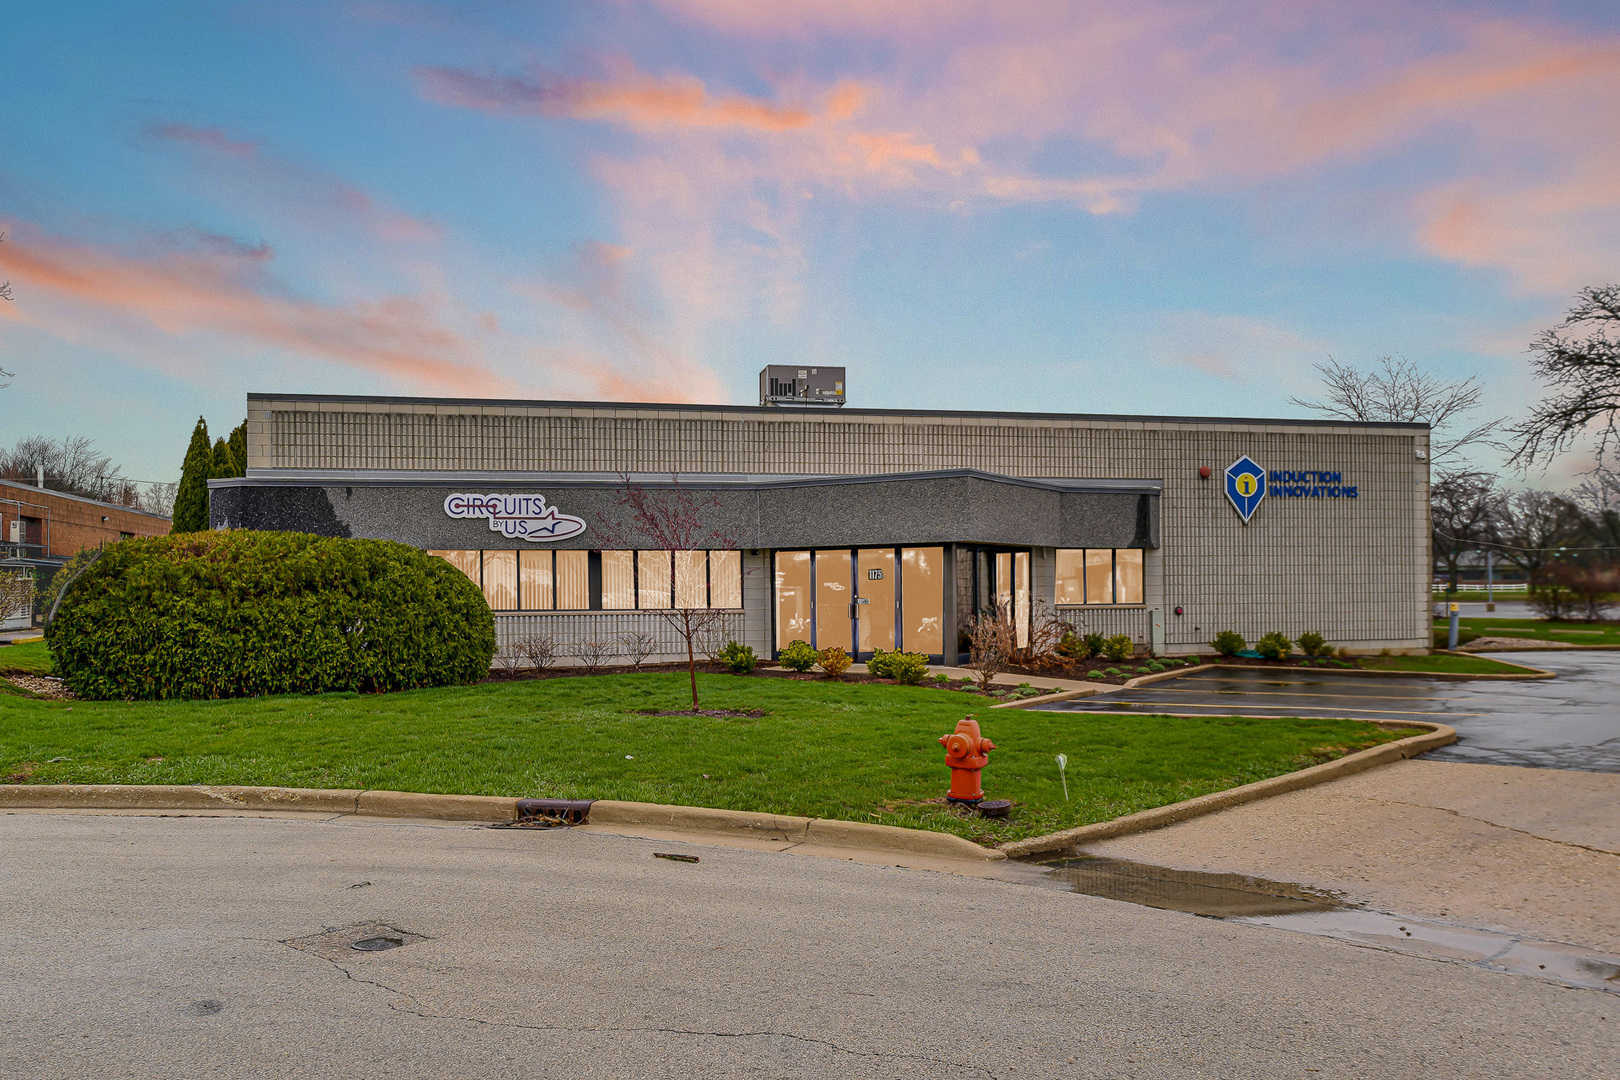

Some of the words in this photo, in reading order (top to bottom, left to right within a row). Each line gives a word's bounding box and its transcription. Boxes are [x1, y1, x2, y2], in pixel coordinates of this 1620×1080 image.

[1269, 471, 1341, 483] INDUCTION
[1269, 486, 1358, 498] INNOVATIONS
[448, 497, 543, 515] CIRCUITS
[492, 520, 504, 528] BY
[505, 520, 528, 535] US
